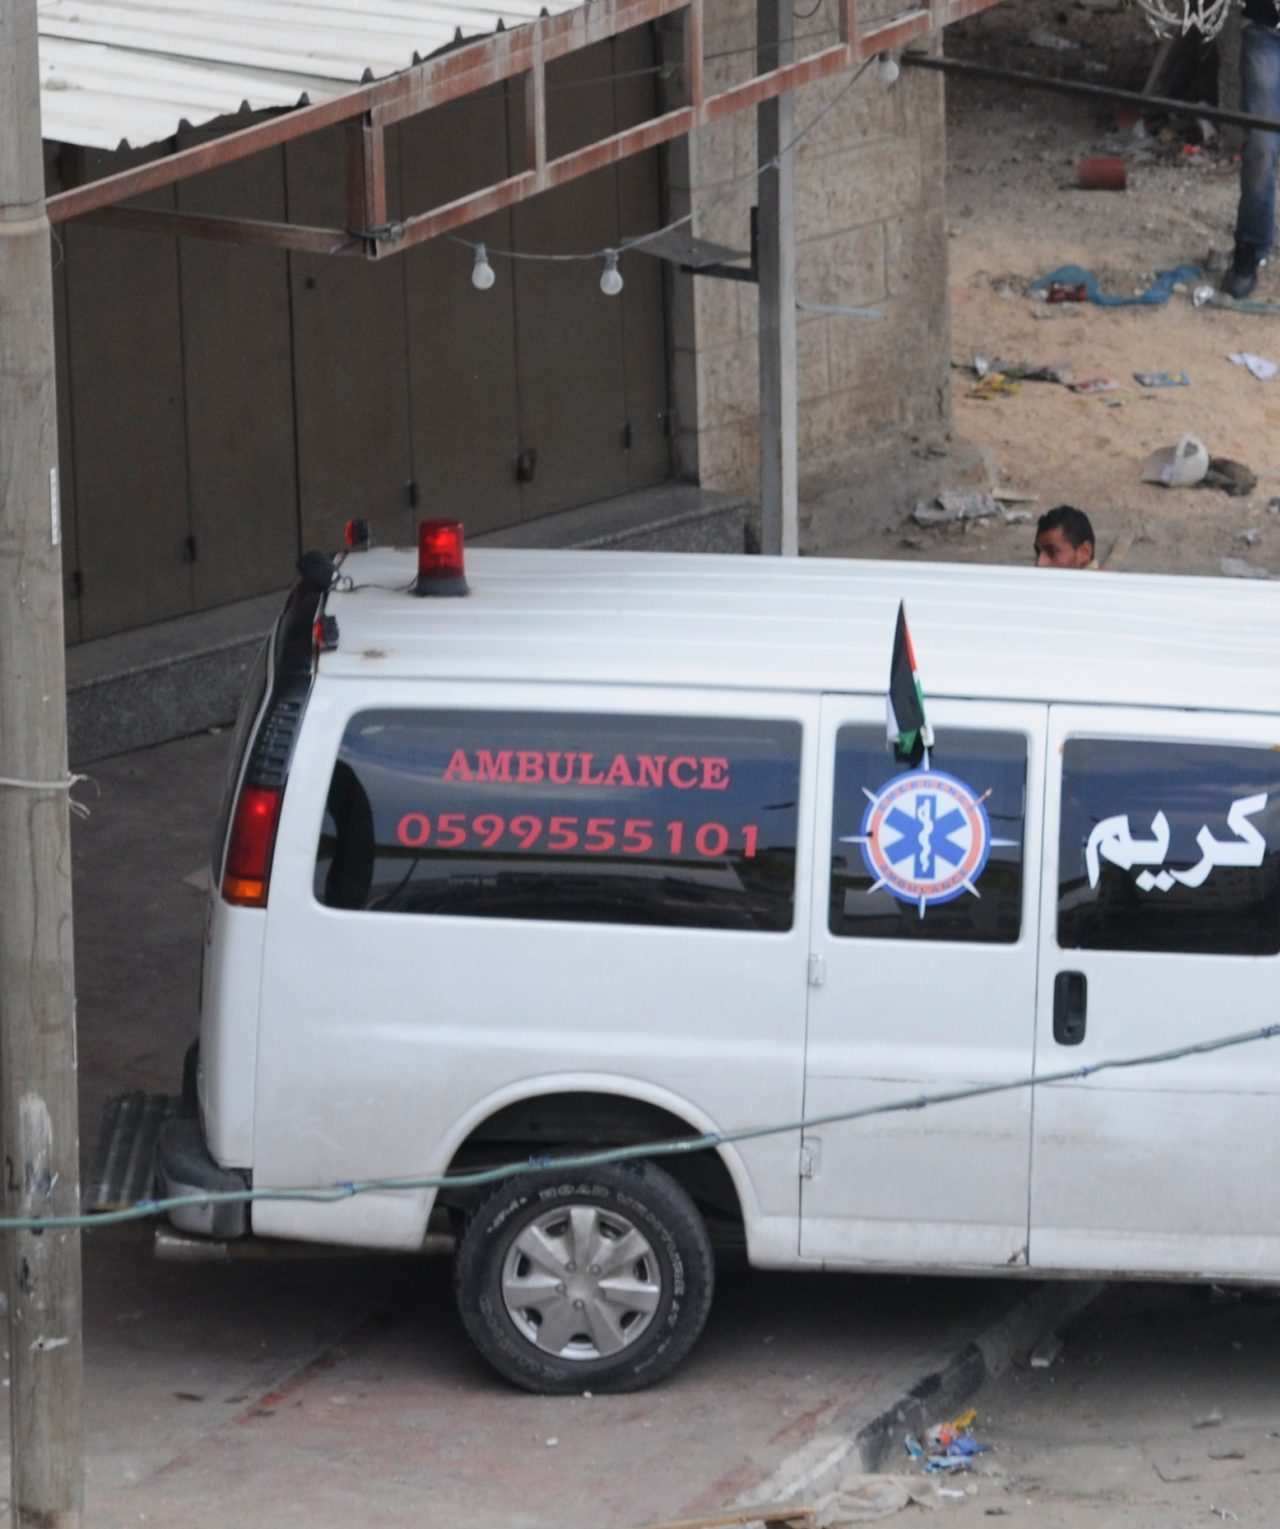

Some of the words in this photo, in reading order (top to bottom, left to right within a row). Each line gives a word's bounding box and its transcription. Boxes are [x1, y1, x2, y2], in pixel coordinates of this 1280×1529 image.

[443, 749, 730, 791] AMBULANCE
[397, 812, 759, 859] 0599555101
[1086, 792, 1268, 892] كريم
